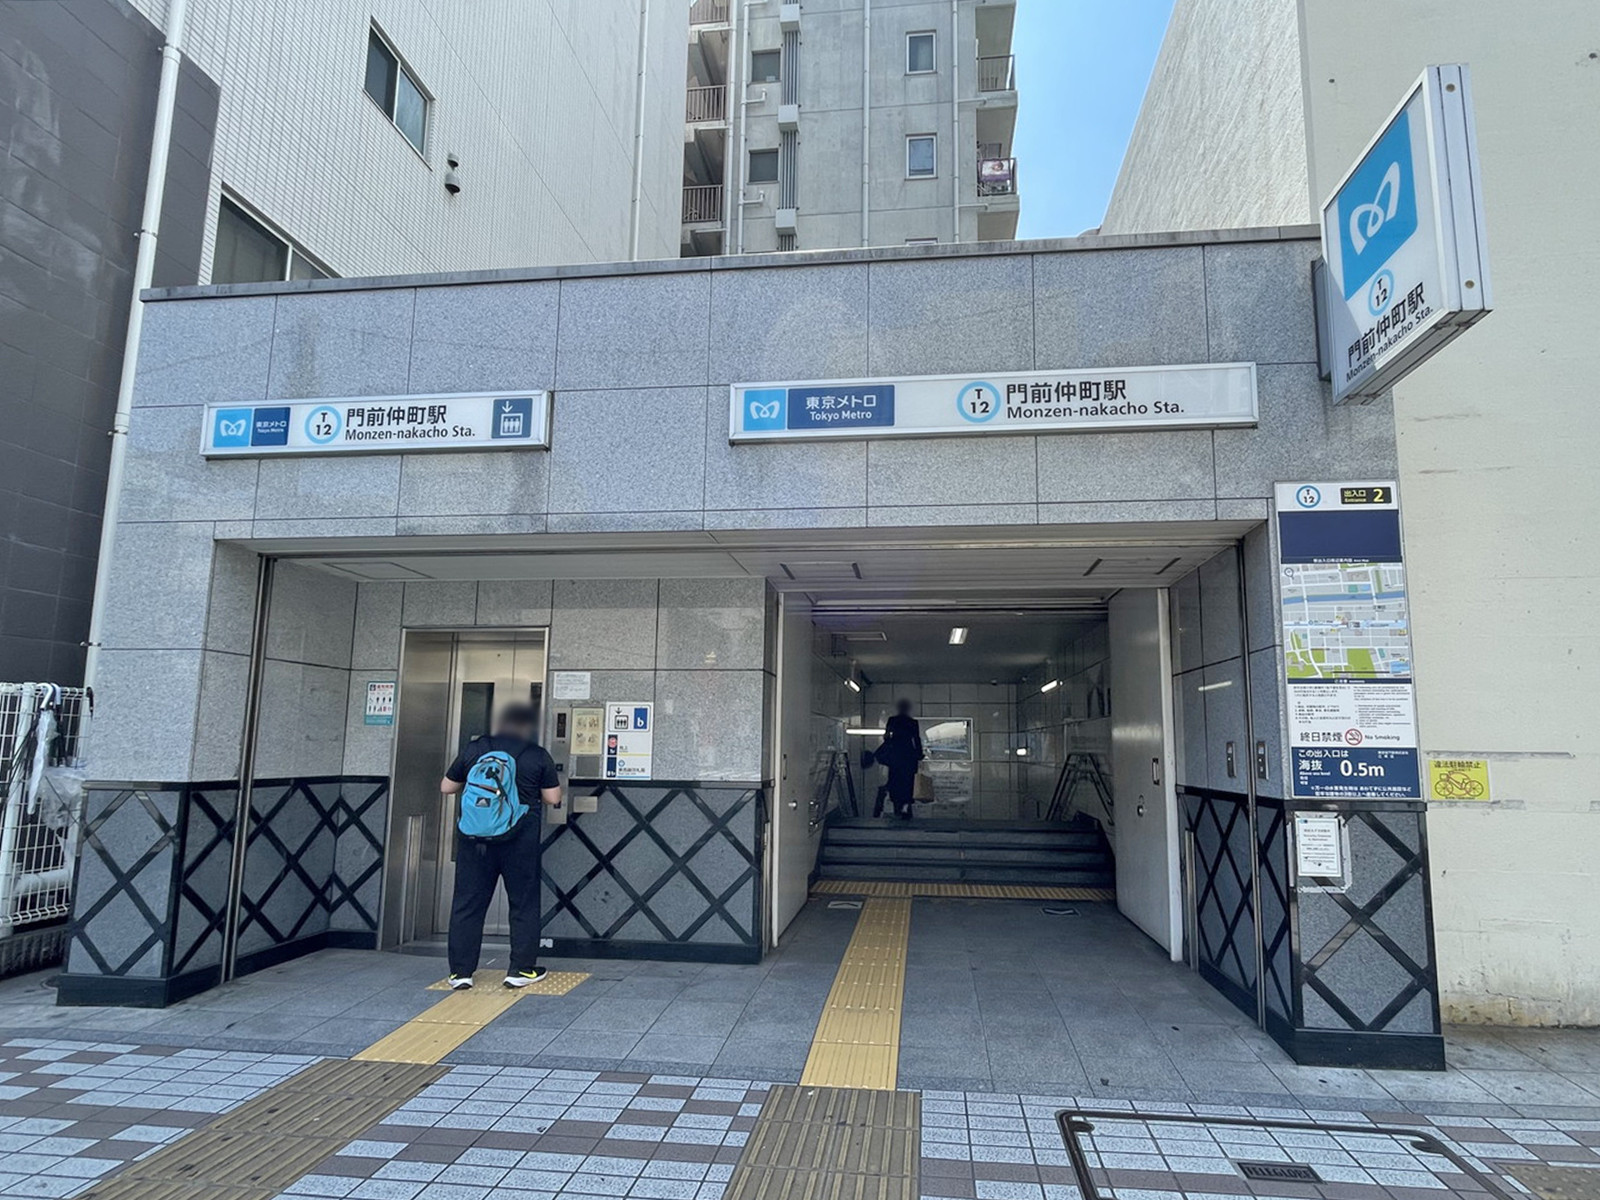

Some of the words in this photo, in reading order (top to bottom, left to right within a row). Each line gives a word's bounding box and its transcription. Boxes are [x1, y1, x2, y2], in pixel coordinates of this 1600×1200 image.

[1377, 278, 1383, 290] T
[1375, 288, 1388, 307] 12
[1348, 282, 1425, 368] 門前仲町駅
[1346, 321, 1413, 382] Monzen-nakacho
[1415, 306, 1434, 325] Sta.
[975, 389, 983, 399] T
[1006, 379, 1127, 404] 門前仲町駅
[806, 395, 876, 410] 東京メトロ
[970, 402, 990, 414] 12
[346, 405, 447, 427] 門前仲町駅
[810, 411, 840, 422] Tokyo
[841, 410, 872, 420] Metro
[1007, 402, 1148, 419] Monzen-nakacho
[1154, 401, 1184, 414] Sta.
[321, 412, 328, 422] T
[316, 424, 332, 435] 12
[345, 425, 448, 441] Monzen-nakacho
[452, 425, 476, 437] Sta.
[1373, 489, 1384, 502] 2
[637, 717, 644, 727] b
[1300, 732, 1342, 742] 終日禁煙
[1299, 750, 1348, 758] この出入口は
[1299, 760, 1322, 770] 海抜
[1340, 760, 1384, 776] 0.5m
